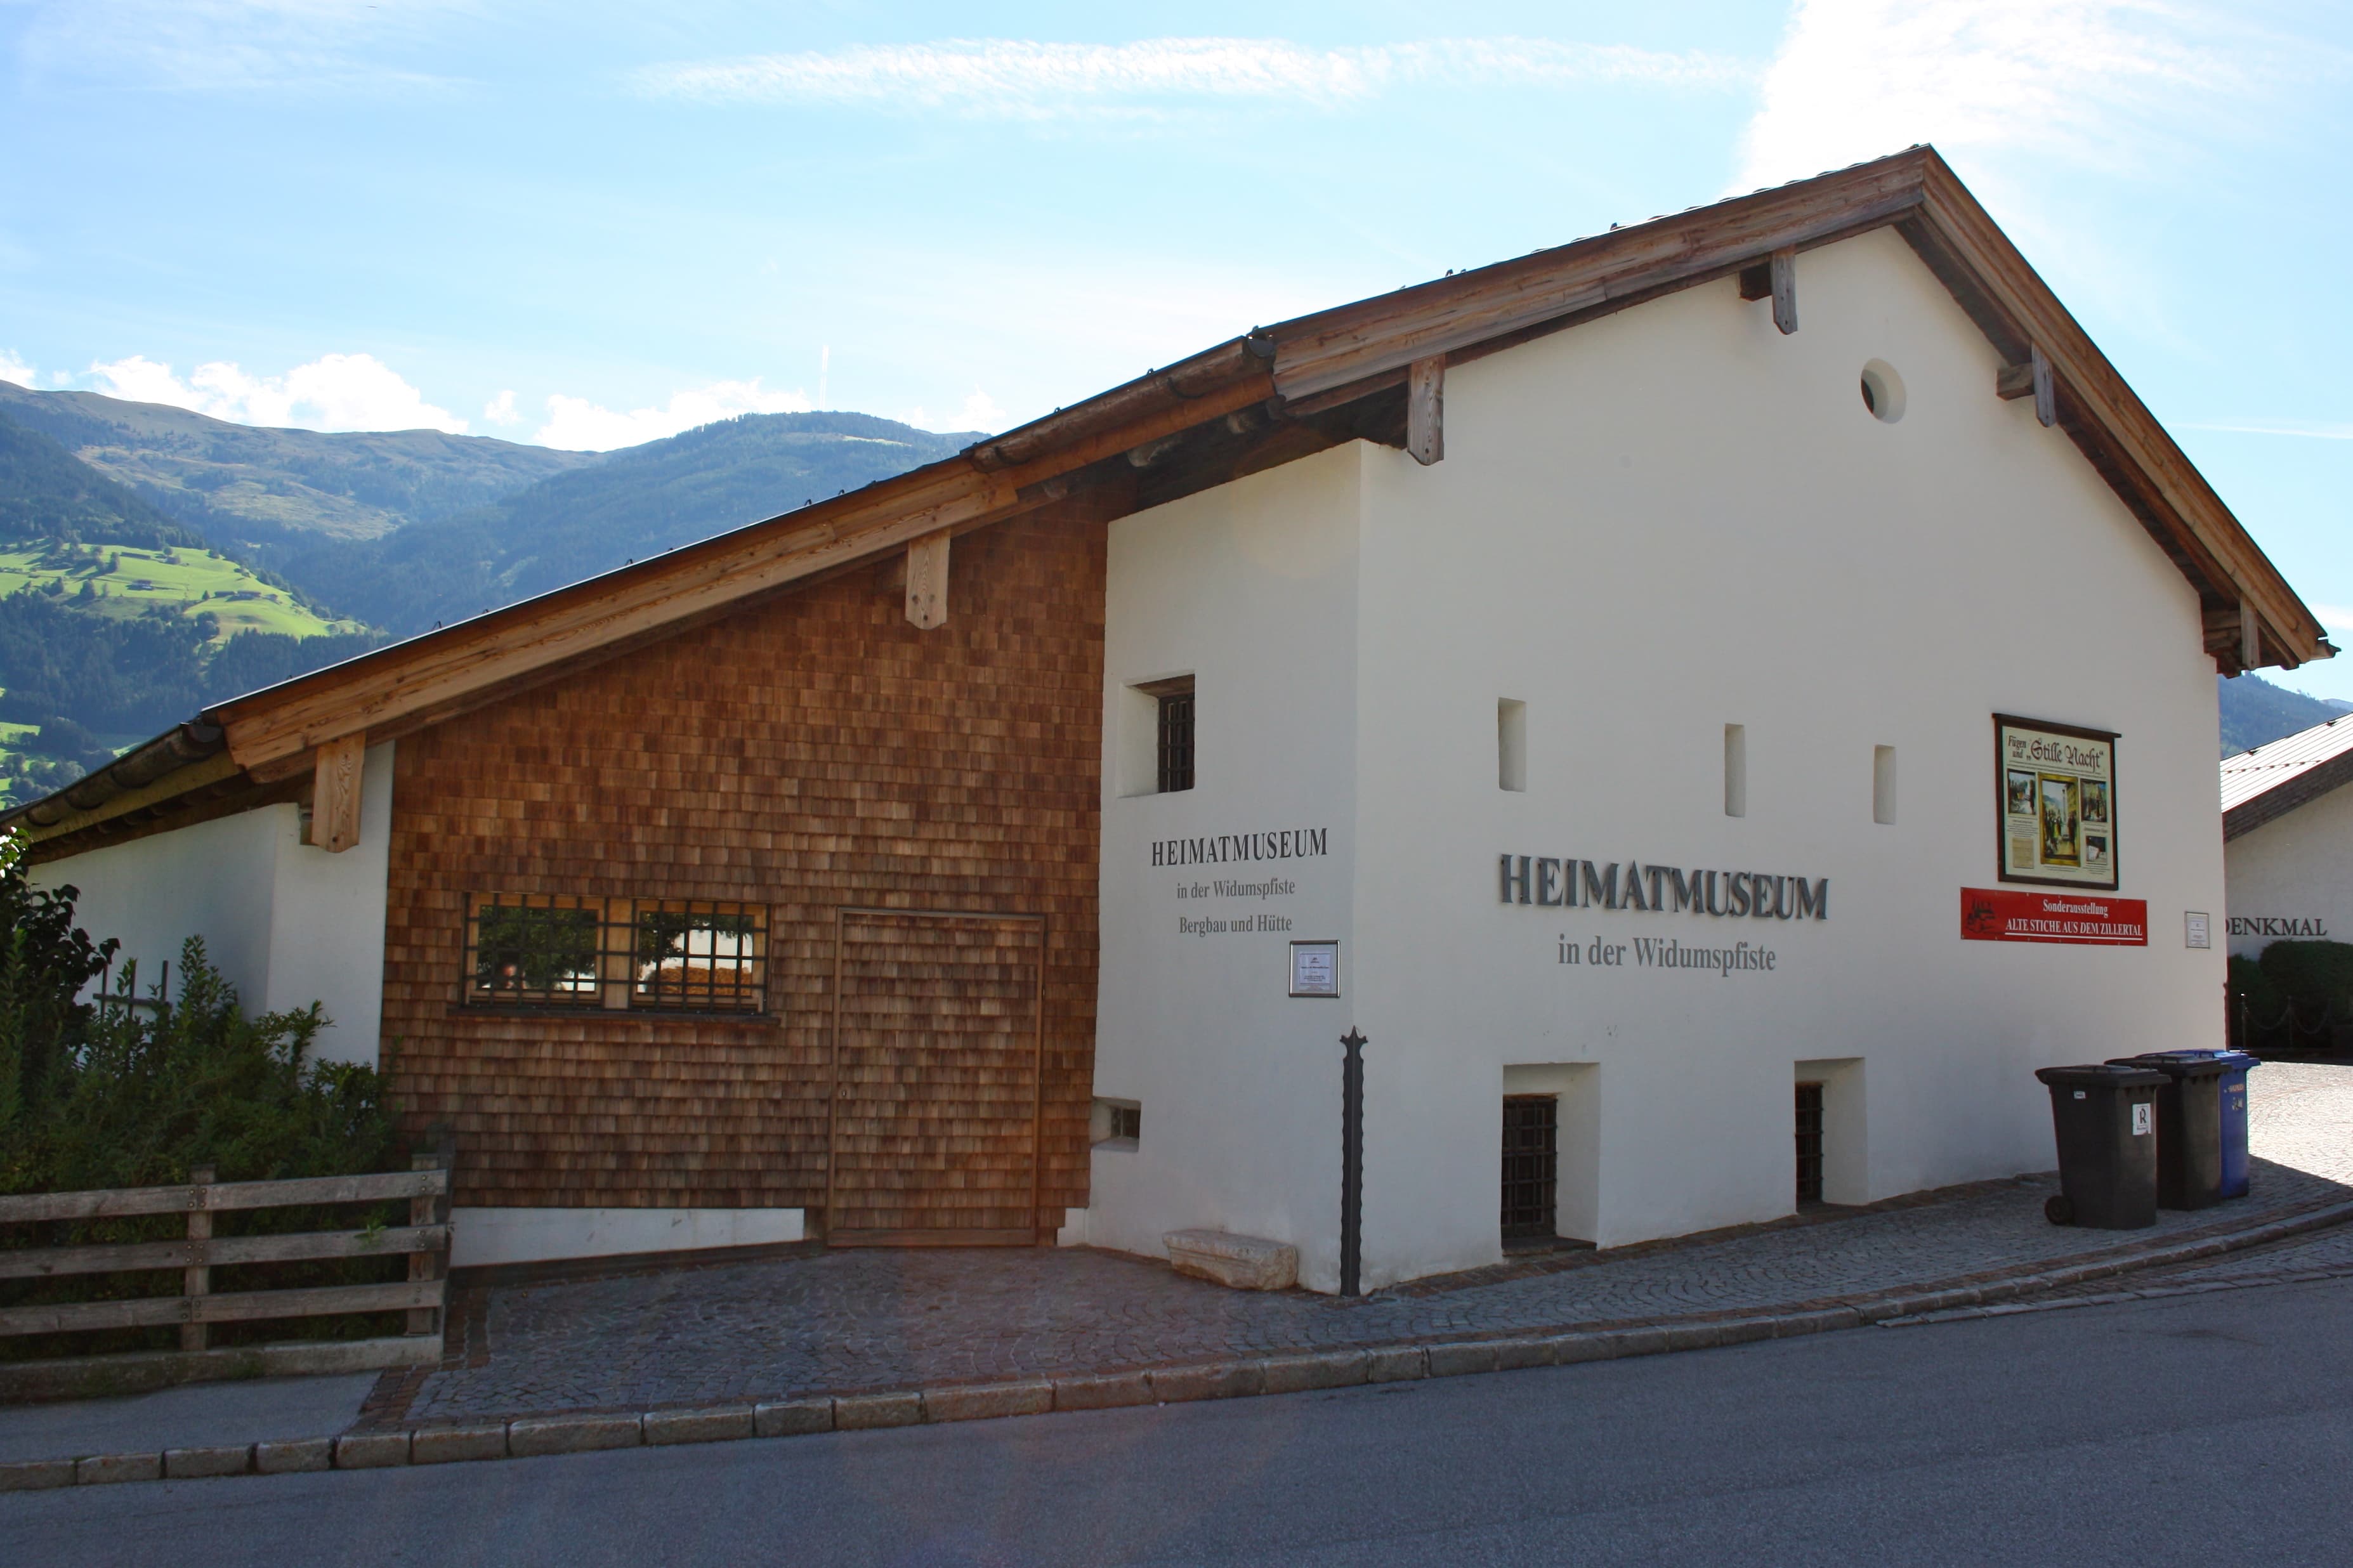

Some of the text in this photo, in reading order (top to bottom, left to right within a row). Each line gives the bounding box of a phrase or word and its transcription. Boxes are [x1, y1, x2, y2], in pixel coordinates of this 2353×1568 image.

[2008, 735, 2026, 748] Fügen
[2012, 749, 2023, 759] und
[1151, 827, 1328, 866] HEIMATMUSEUM
[1177, 877, 1295, 900] in der Widumspfiste
[1500, 854, 1829, 920] HEIMATMUSEUM
[2043, 899, 2109, 918] Sonderausstellung
[1179, 914, 1293, 938] Bergbau und Hütte
[2005, 918, 2142, 936] ALTE STICHE AUS DEM ZILLERTAL
[2225, 917, 2328, 936] ENKMAL
[1558, 934, 1776, 977] in der Widumspfiste
